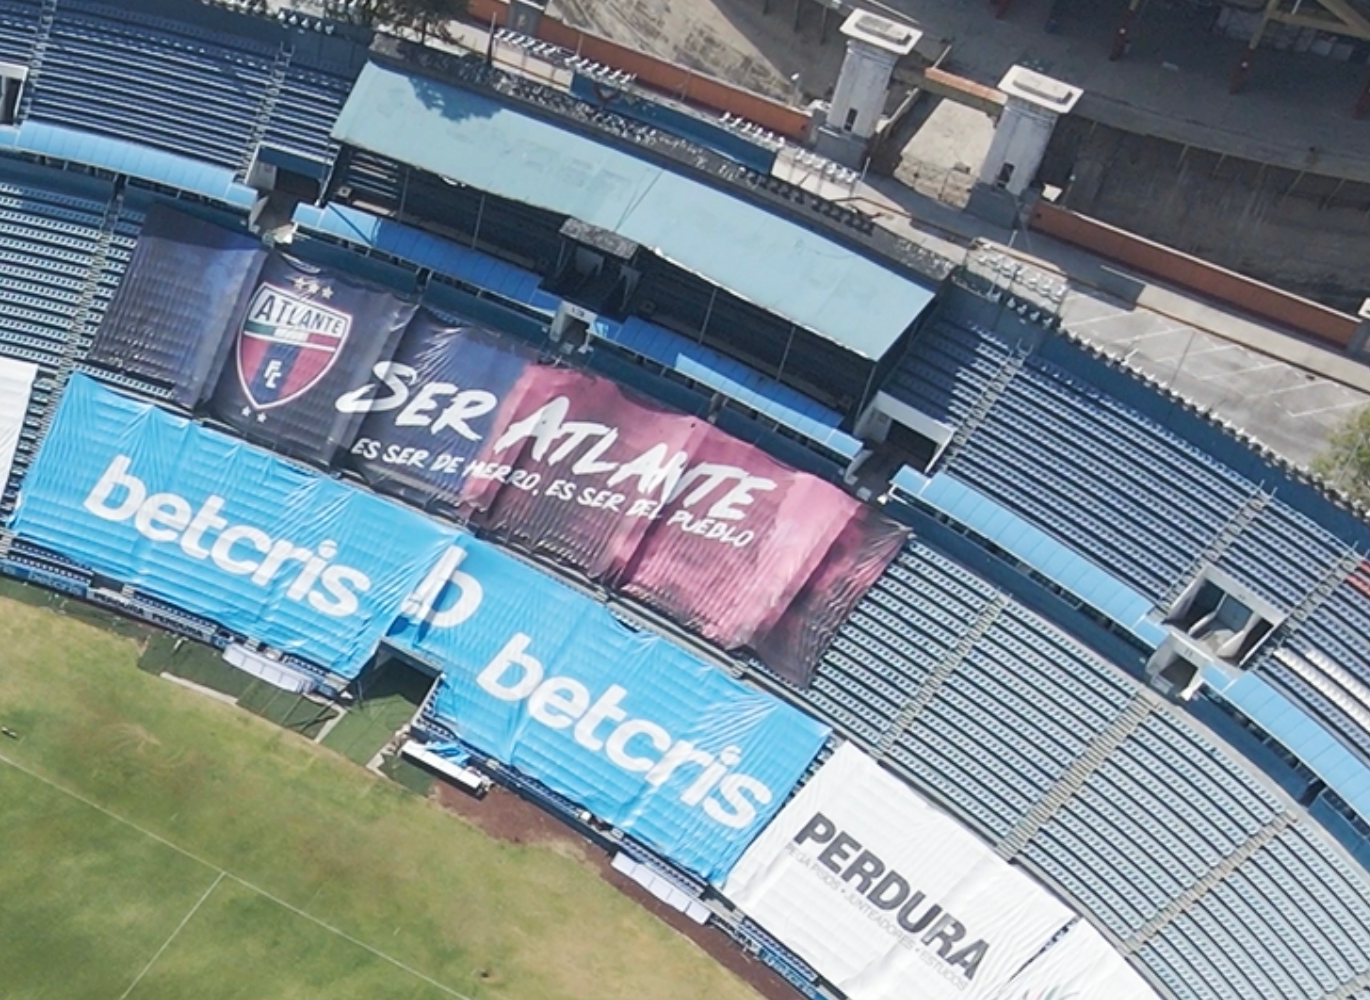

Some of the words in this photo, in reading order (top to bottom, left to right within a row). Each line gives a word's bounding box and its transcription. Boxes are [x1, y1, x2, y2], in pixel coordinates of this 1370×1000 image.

[254, 294, 343, 334] ATLANTE
[264, 359, 283, 389] FC
[334, 360, 498, 442] SER
[493, 394, 779, 521] ATLANTE
[350, 438, 379, 460] ES
[382, 444, 430, 468] SER
[430, 452, 464, 474] DE
[544, 479, 578, 502] ES
[577, 487, 626, 514] SER
[666, 509, 755, 547] PUEBLO
[83, 454, 372, 617] betcris
[402, 544, 484, 629] b
[475, 631, 774, 830] betcris
[793, 811, 990, 981] PERDURA
[843, 891, 917, 951] JUNTEADORES
[919, 949, 970, 992] ESTUCOS
